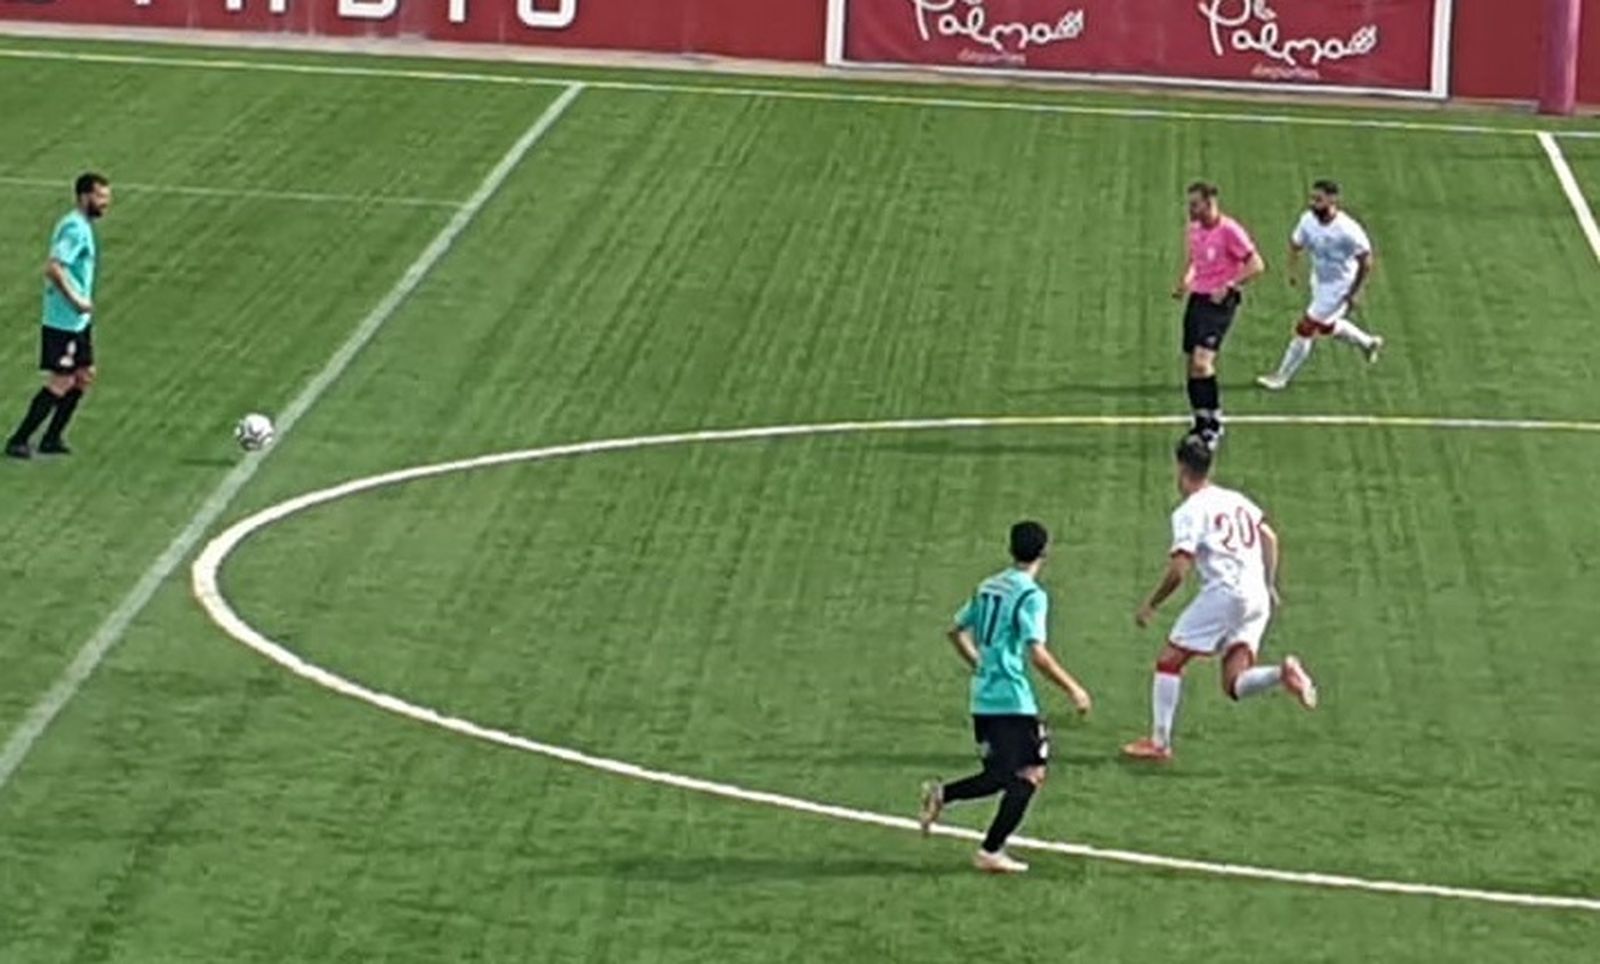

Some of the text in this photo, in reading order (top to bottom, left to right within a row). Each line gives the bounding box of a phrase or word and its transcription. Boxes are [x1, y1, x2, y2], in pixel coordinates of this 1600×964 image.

[1199, 0, 1376, 65] Palma
[1215, 506, 1255, 554] 20
[978, 592, 1004, 643] 11
